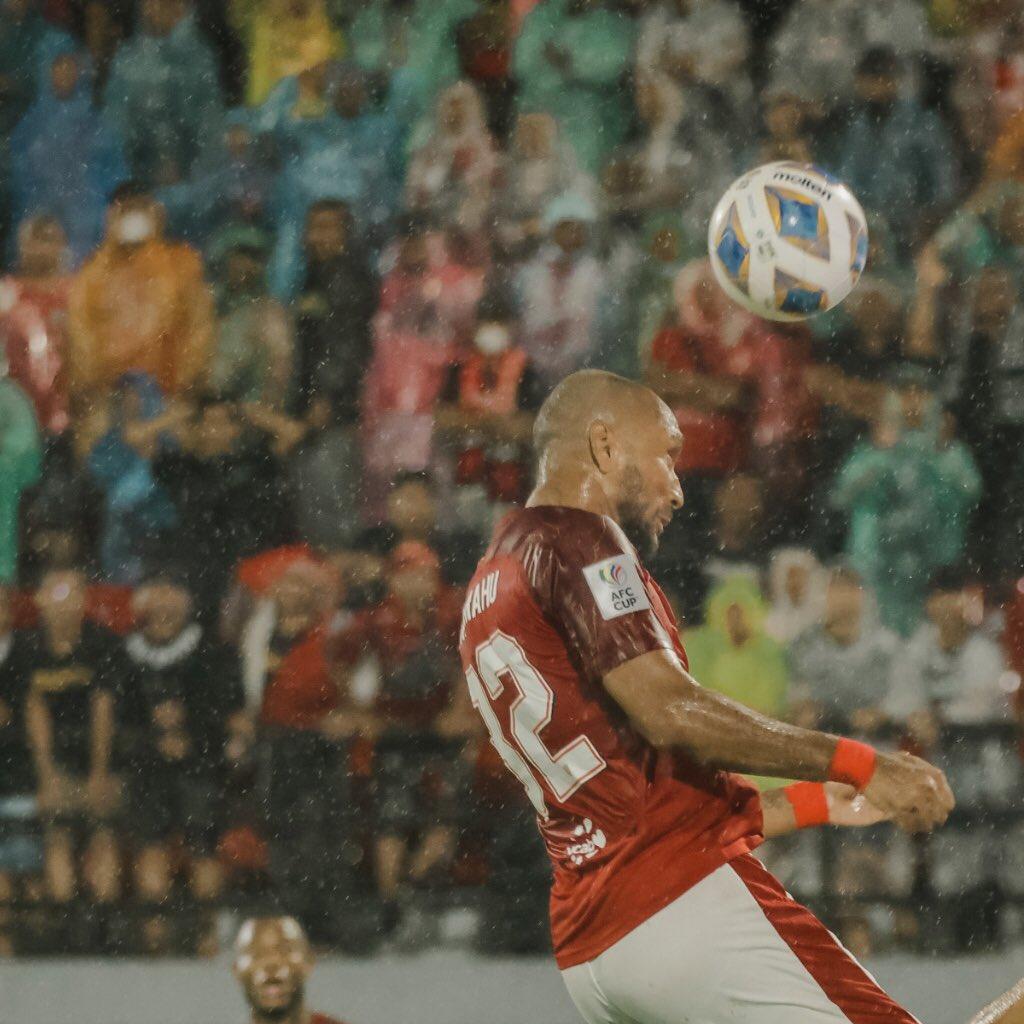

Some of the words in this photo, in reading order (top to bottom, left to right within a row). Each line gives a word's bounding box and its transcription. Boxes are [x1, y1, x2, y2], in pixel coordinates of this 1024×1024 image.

[772, 171, 833, 201] molten
[611, 587, 635, 602] AFC
[613, 597, 637, 611] CUP
